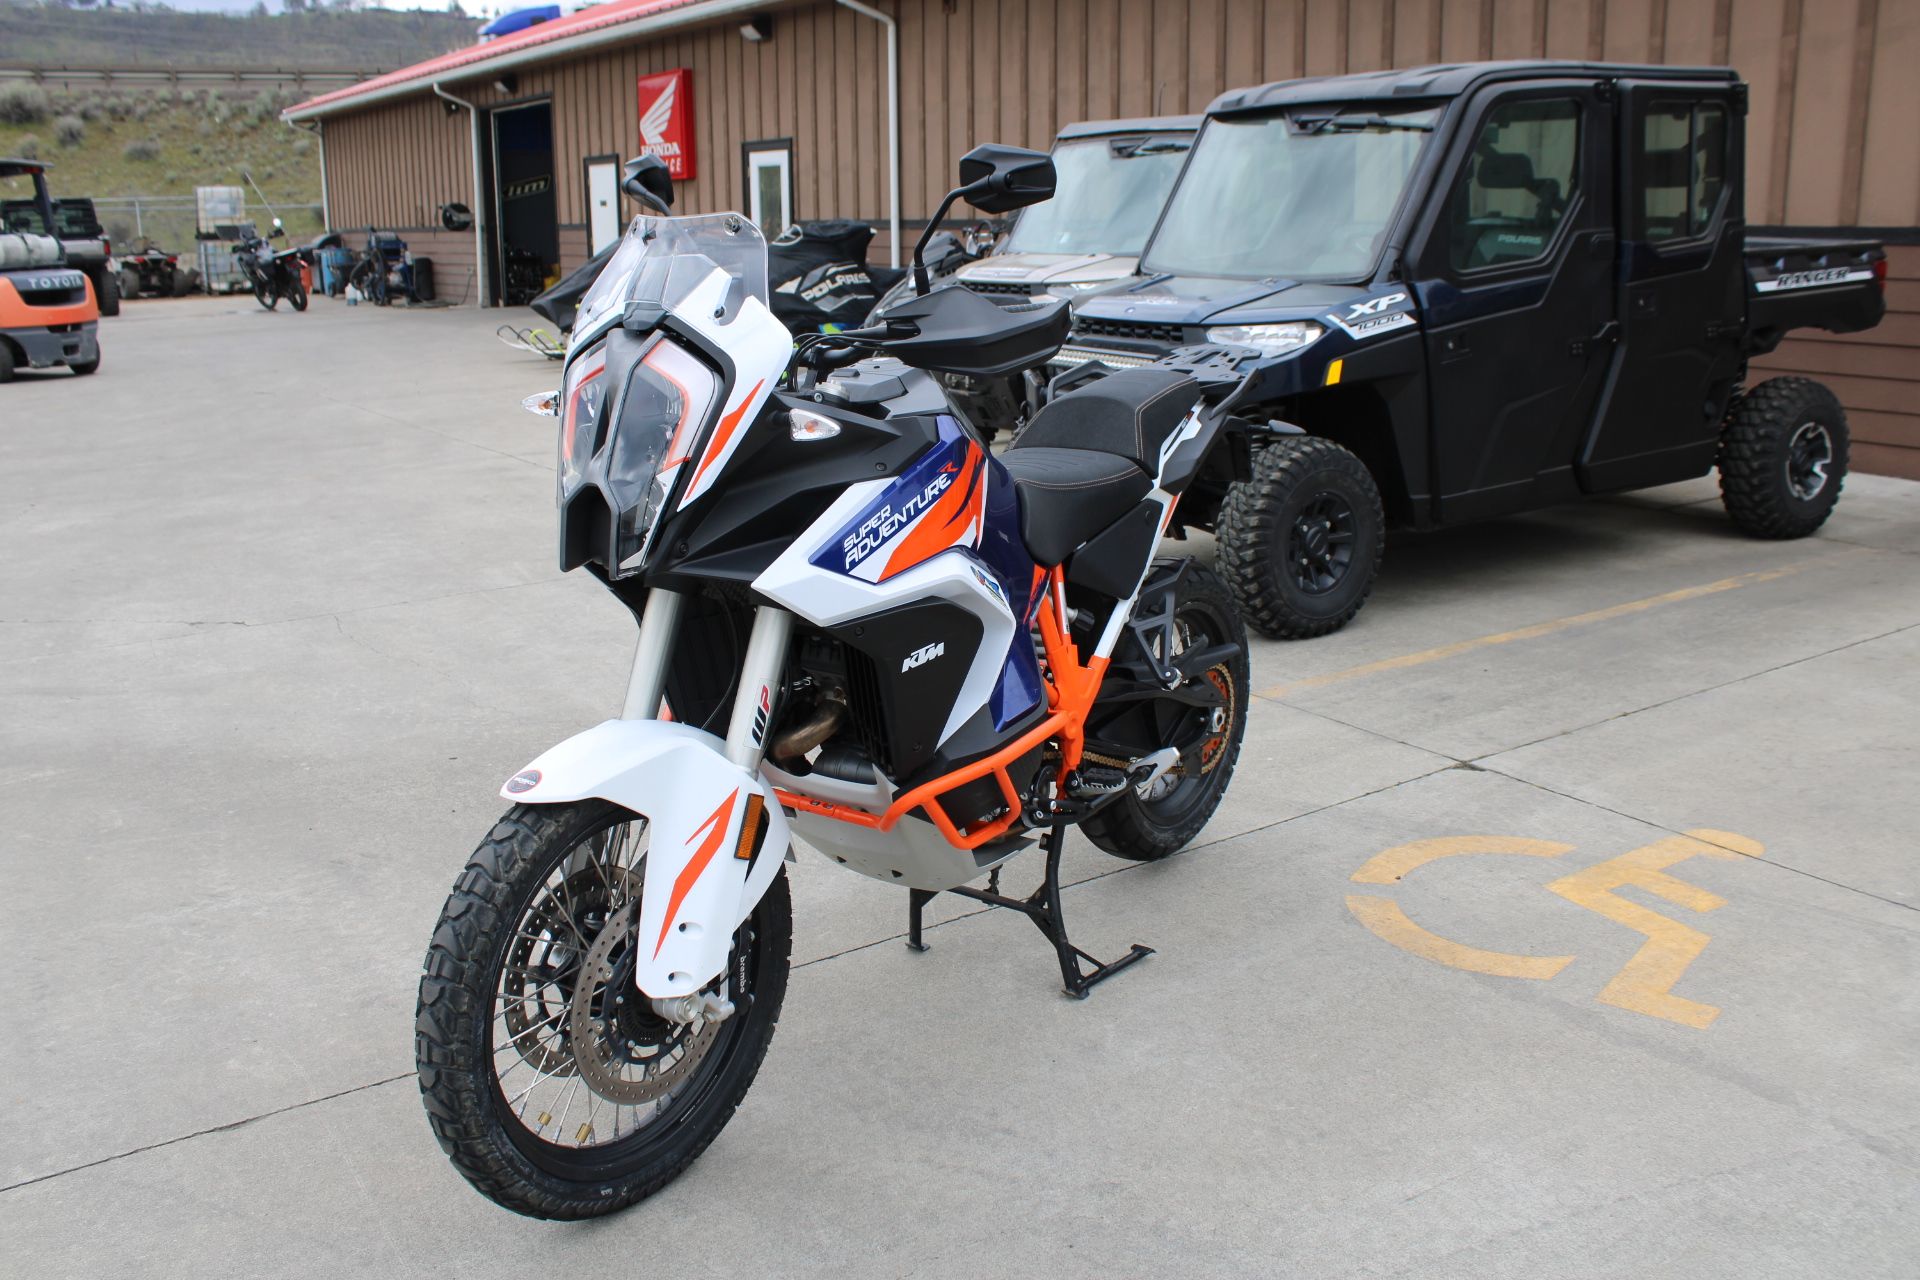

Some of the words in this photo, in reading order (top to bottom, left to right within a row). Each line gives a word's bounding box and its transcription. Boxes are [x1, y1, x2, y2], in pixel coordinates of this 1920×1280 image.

[641, 142, 681, 157] HONDA
[27, 275, 83, 289] TOYOTA
[801, 272, 871, 302] POLARIS
[1777, 266, 1850, 289] RANGER
[1345, 292, 1407, 320] XP
[844, 504, 891, 553] SUPER
[845, 473, 951, 570] ADVENTURE
[901, 641, 945, 674] KTM
